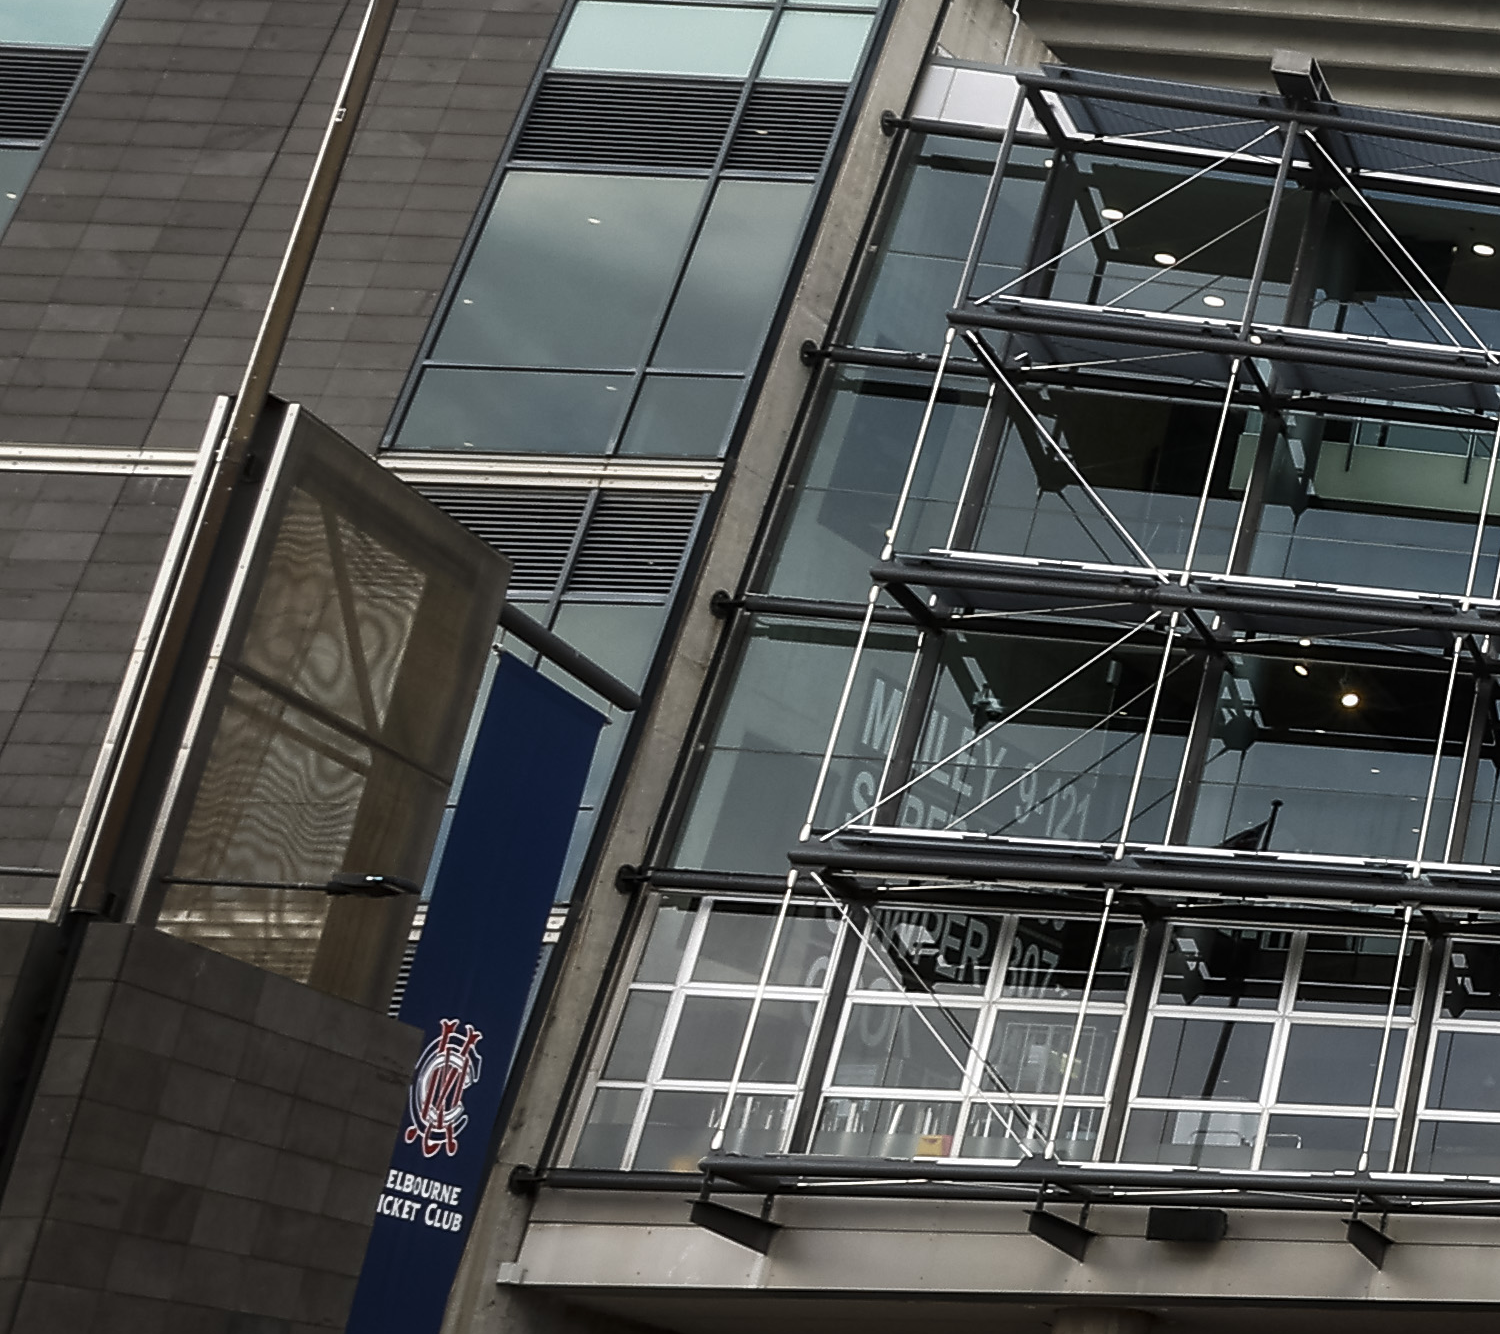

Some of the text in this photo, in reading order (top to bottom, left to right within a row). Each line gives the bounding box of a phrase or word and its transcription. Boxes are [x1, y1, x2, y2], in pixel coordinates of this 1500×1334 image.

[385, 1169, 462, 1206] ELBOURNE
[376, 1193, 463, 1232] ICKET CLUB
